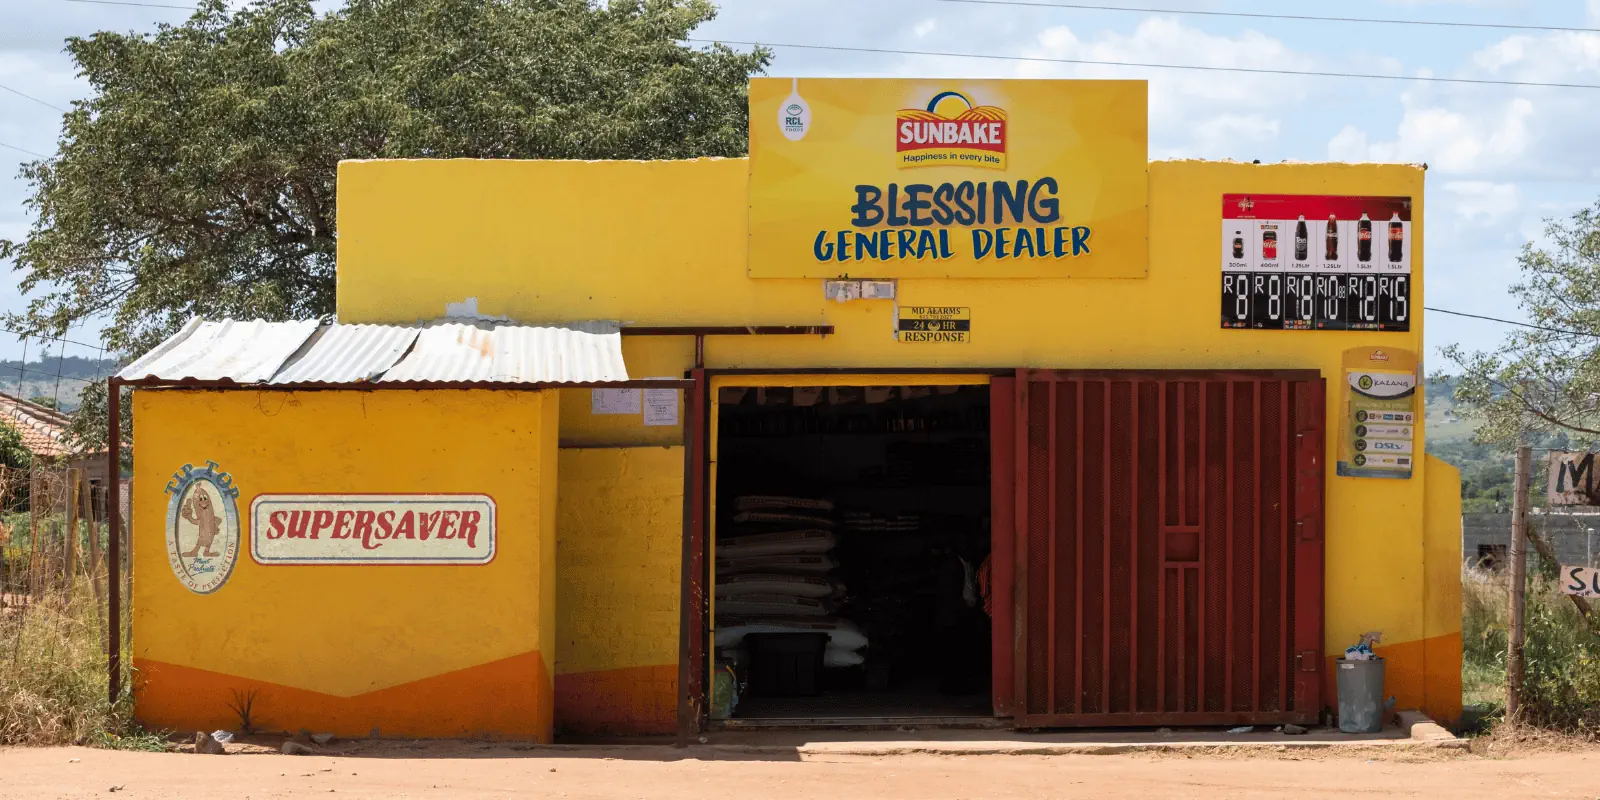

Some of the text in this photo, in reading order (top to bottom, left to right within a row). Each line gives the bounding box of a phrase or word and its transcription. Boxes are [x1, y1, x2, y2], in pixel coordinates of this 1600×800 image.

[786, 117, 803, 125] RCL
[900, 122, 1002, 145] SUNBAKE
[903, 152, 1001, 164] Happiness in every bite
[850, 176, 1060, 228] BLESSING
[813, 226, 1092, 261] GENERAL DEALER
[911, 307, 925, 315] MD
[904, 331, 965, 342] RESPONSE
[913, 321, 957, 330] 24 HR
[1373, 379, 1409, 388] KAZANG
[163, 459, 240, 500] TIP TOP
[1556, 453, 1600, 498] M
[266, 510, 481, 550] SUPERSAVER
[170, 551, 188, 581] TASTE
[187, 580, 199, 590] OF
[201, 541, 236, 591] PERFECTION
